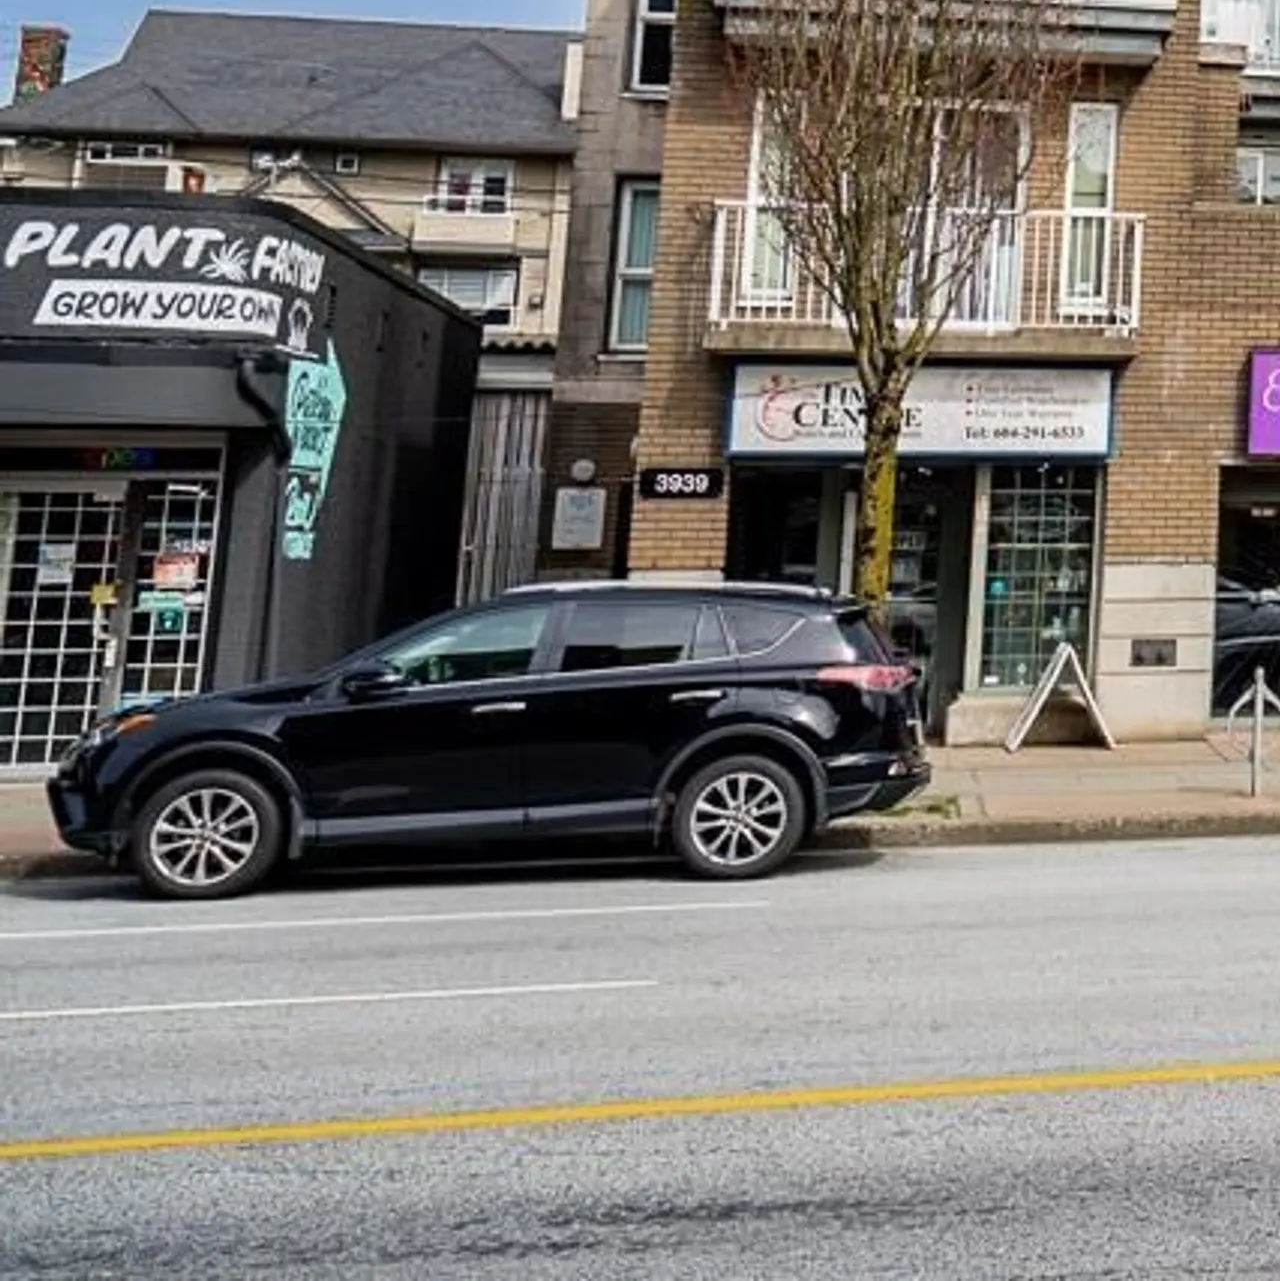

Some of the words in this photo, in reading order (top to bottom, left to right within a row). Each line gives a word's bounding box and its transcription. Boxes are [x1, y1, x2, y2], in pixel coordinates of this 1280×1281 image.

[4, 221, 226, 269] PLANT
[52, 291, 148, 319] GROW
[152, 293, 236, 319] YOUR
[792, 401, 923, 428] CENE
[654, 472, 710, 494] 3939
